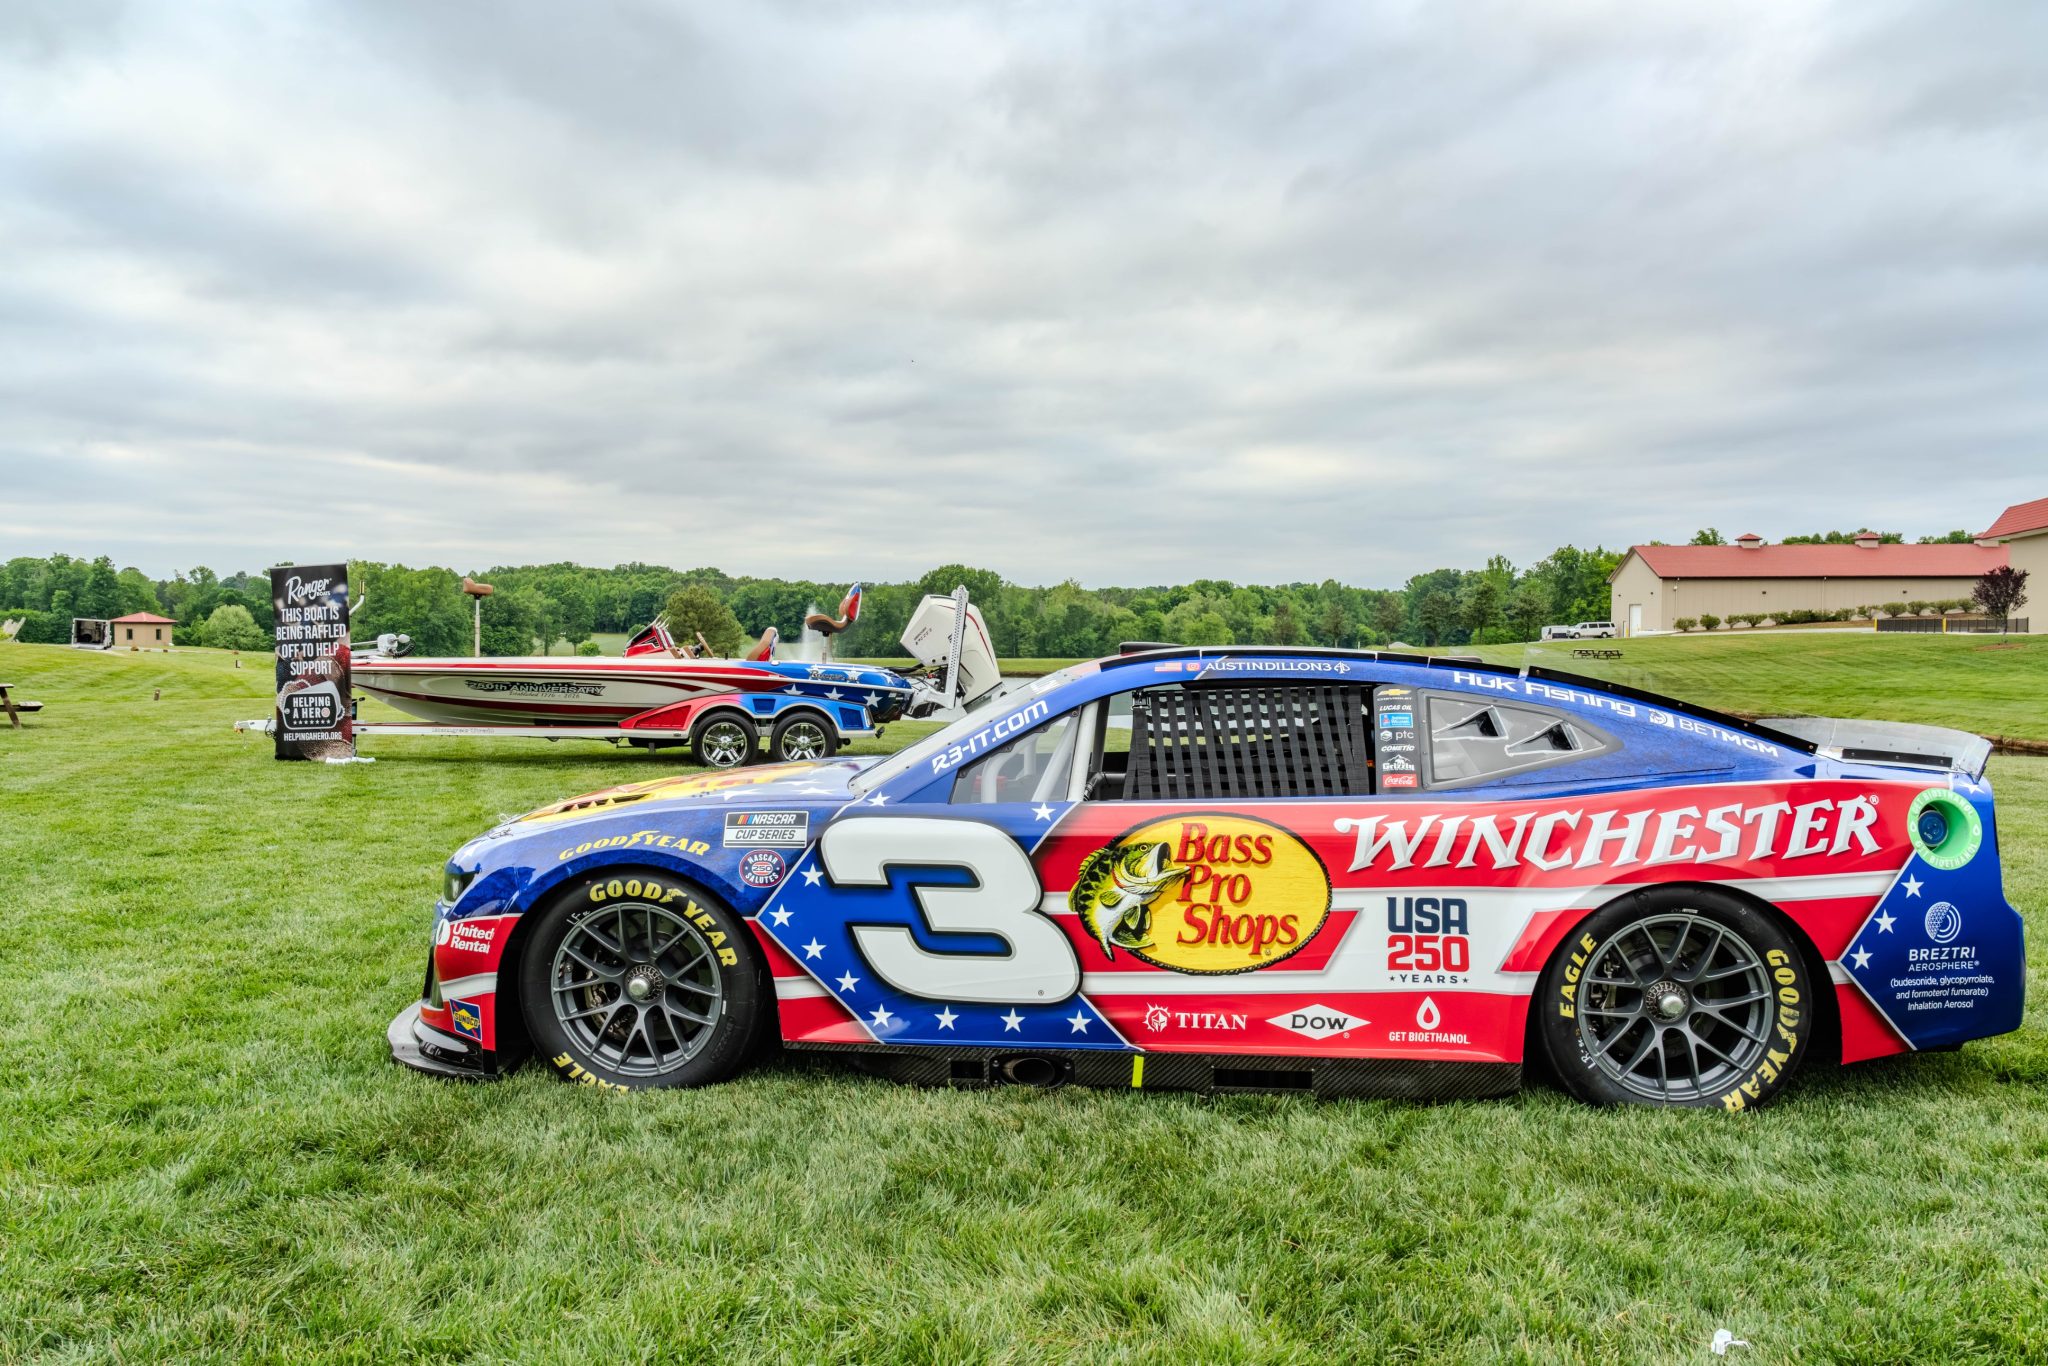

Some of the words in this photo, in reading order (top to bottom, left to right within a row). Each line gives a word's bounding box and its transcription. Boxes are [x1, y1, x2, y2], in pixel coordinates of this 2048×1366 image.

[285, 576, 331, 604] Ranger
[281, 608, 302, 622] THIS
[304, 606, 329, 621] BOAT
[330, 606, 340, 620] IS
[276, 625, 303, 640] BEING
[304, 624, 346, 639] RAFFLED
[282, 644, 299, 658] OFF
[301, 643, 313, 657] TO
[316, 642, 339, 656] HELP
[290, 660, 332, 675] SUPPORT
[1205, 662, 1332, 671] AUSTINDILLON3
[510, 684, 606, 695] ANNIVERSARY
[293, 696, 331, 708] HELPING
[293, 708, 299, 719] A
[284, 732, 342, 741] HELPINGAHERO.ORG
[1396, 730, 1414, 740] ptc
[752, 814, 796, 824] NASCAR
[736, 829, 757, 839] CUP
[759, 829, 796, 840] SERIES
[559, 831, 710, 856] GOODYEAR
[1173, 823, 1272, 864] Bass
[747, 854, 778, 864] NASCAR
[745, 872, 779, 884] SALUTES
[1176, 863, 1251, 903] Pro
[820, 817, 1082, 1004] 3
[1387, 897, 1469, 935] USA
[453, 922, 495, 940] United
[1176, 903, 1299, 955] Shops
[1388, 935, 1469, 972] 250
[1909, 947, 1976, 961] BREZTRI
[1400, 974, 1458, 983] YEARS
[1560, 932, 1597, 1018] EAGLE
[1890, 976, 1939, 988] (budesonide,
[1940, 974, 1995, 986] glycopyrrolate,
[1896, 990, 1911, 999] and
[1912, 987, 1950, 998] formoterol
[1951, 987, 1989, 996] fumarate)
[1908, 1001, 1942, 1011] Inhalation
[1944, 1000, 1974, 1009] Aerosol
[454, 1011, 480, 1028] SUNOCO
[1176, 1012, 1248, 1030] TITAN
[1389, 1031, 1406, 1042] GET
